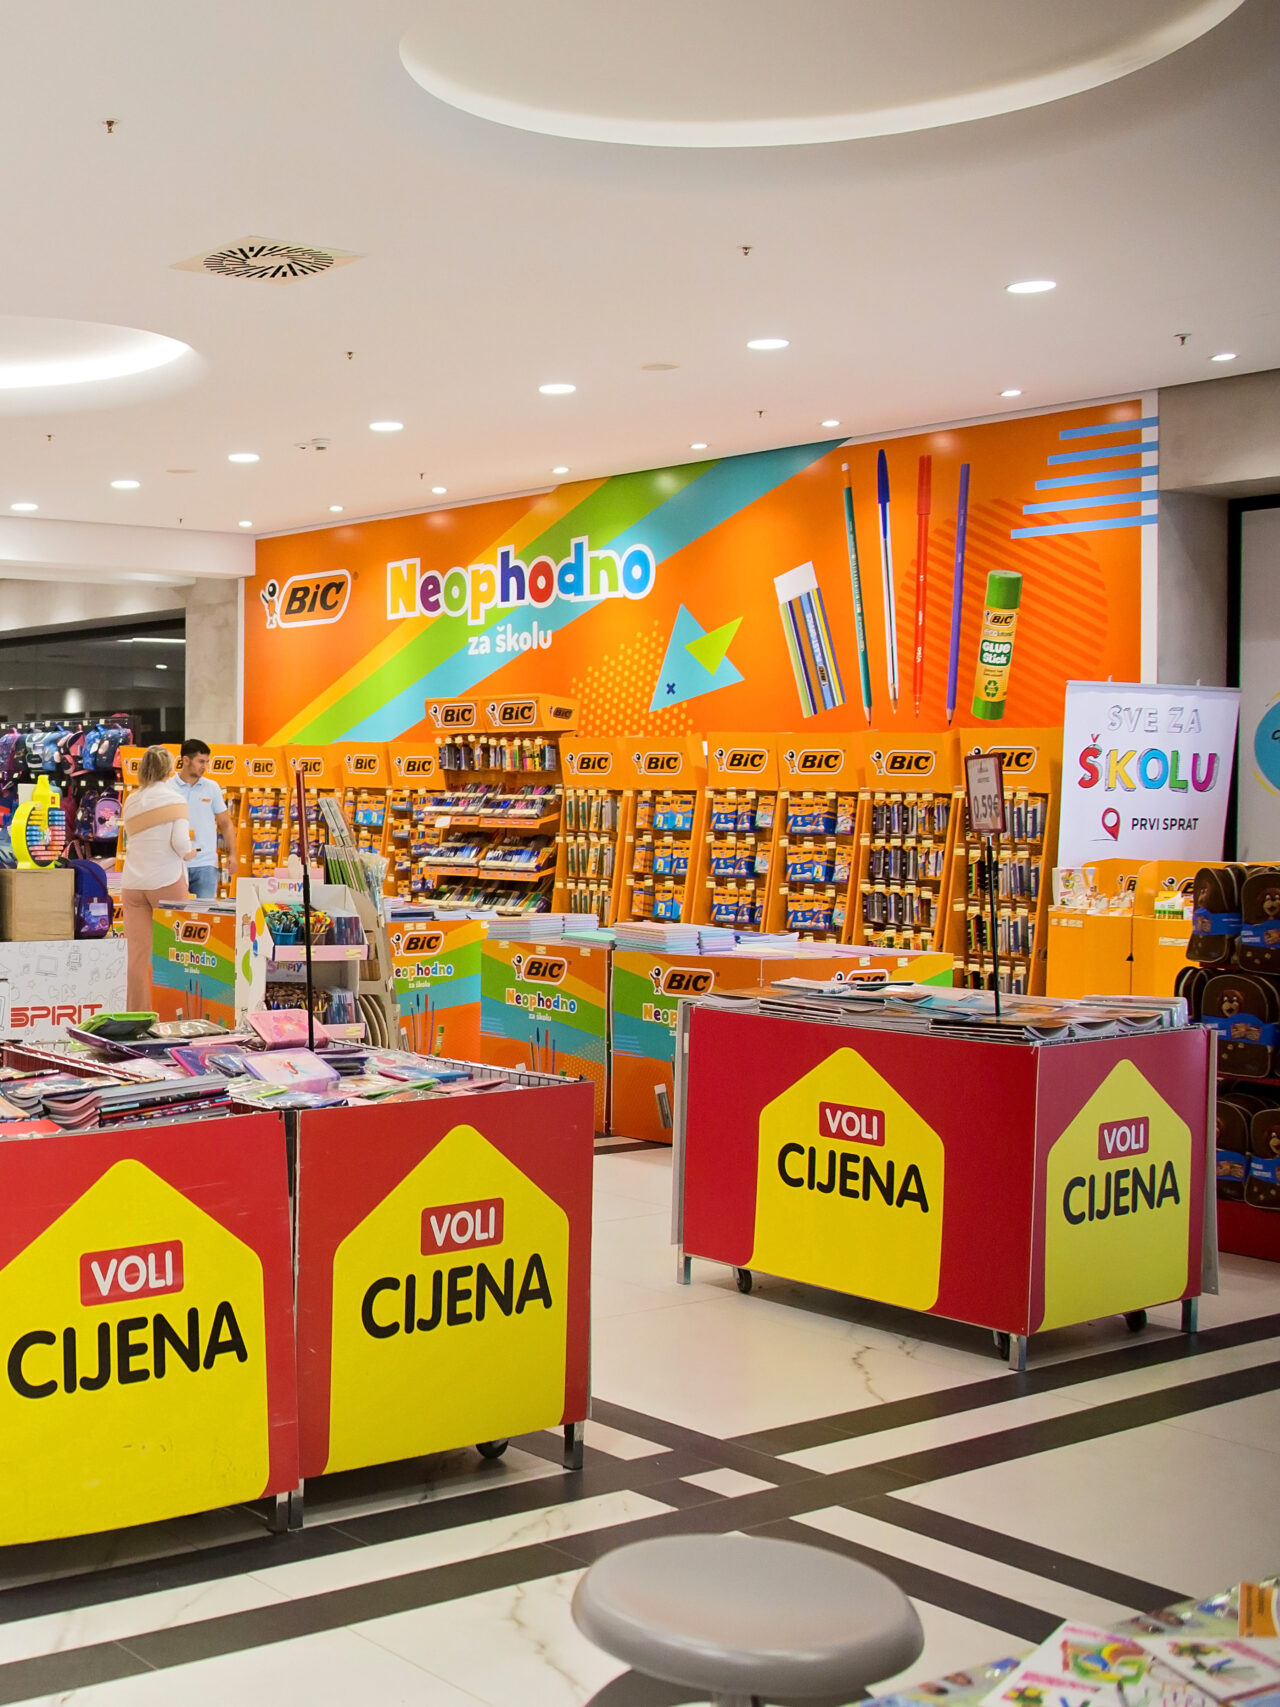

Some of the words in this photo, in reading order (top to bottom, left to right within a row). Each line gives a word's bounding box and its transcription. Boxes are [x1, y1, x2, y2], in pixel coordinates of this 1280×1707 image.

[388, 538, 655, 623] Neophodno
[468, 634, 491, 655] za
[495, 621, 552, 653] školu
[1107, 704, 1158, 733] SVE
[1167, 706, 1202, 733] ZA
[1078, 734, 1220, 793] ŠKOLU
[1131, 817, 1160, 831] PRVI
[1163, 817, 1199, 831] SPRAT
[394, 961, 454, 981] eophodno
[10, 1003, 103, 1028] SPIRIT
[505, 988, 577, 1013] Neophodno
[825, 1108, 878, 1140] VOLI
[1103, 1123, 1145, 1153] VOLI
[777, 1142, 929, 1213] CIJENA
[1063, 1161, 1180, 1225] CIJENA
[430, 1207, 495, 1247] VOLI
[90, 1250, 173, 1297] VOLI
[361, 1253, 553, 1340] CIJENA
[6, 1301, 249, 1399] CIJENA
